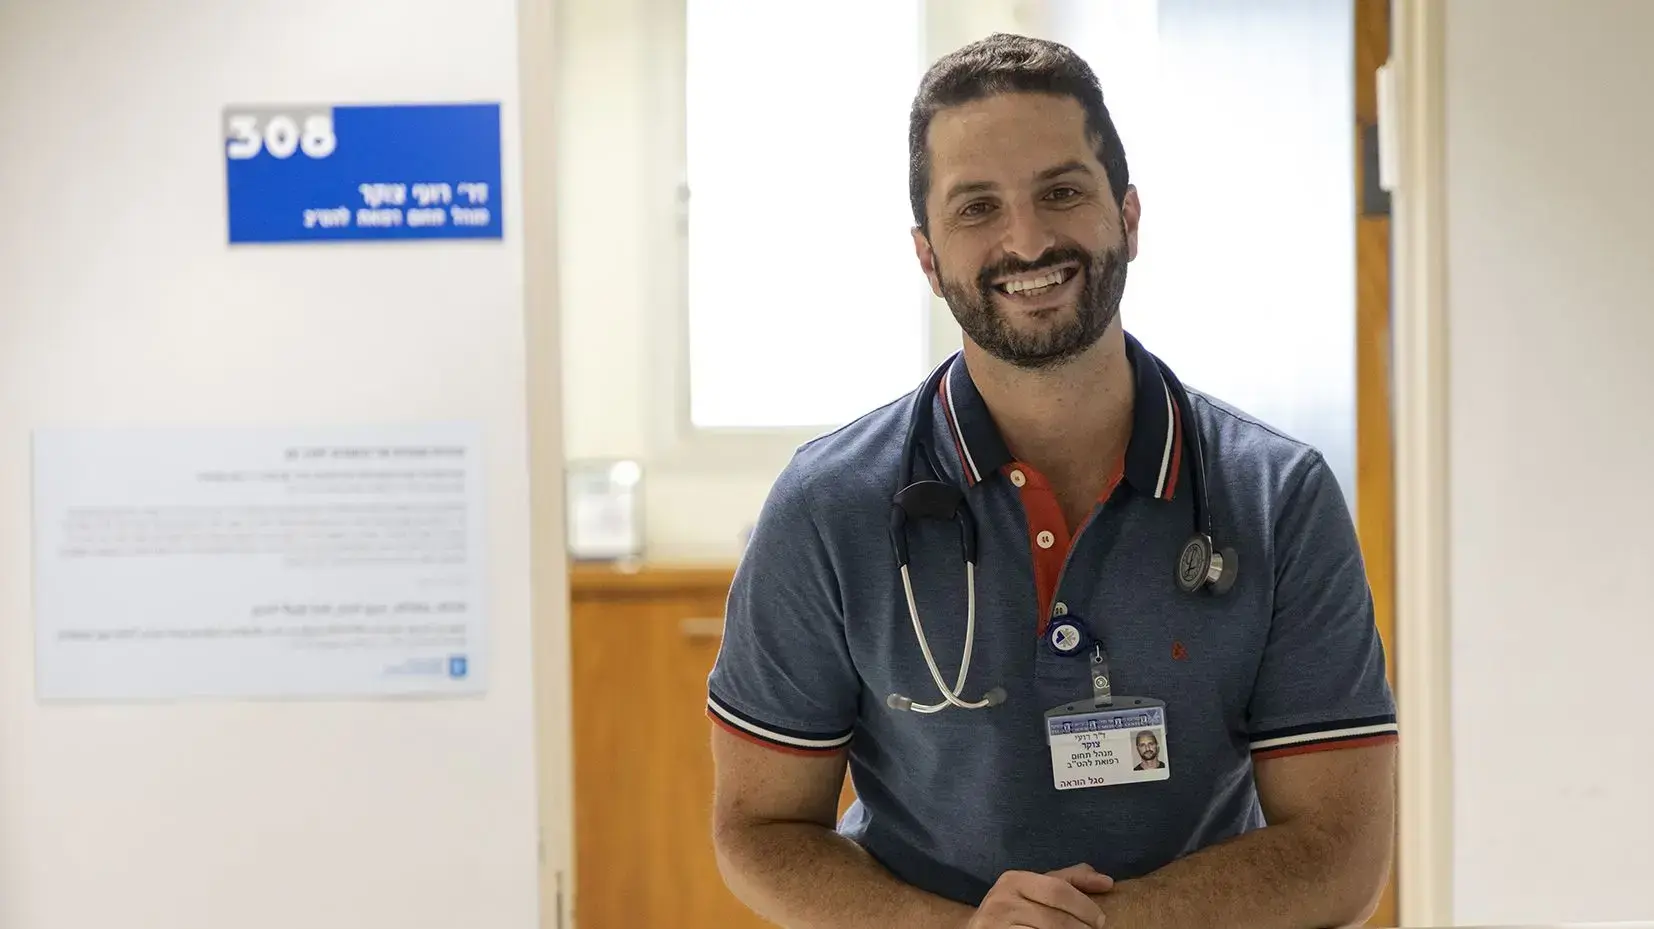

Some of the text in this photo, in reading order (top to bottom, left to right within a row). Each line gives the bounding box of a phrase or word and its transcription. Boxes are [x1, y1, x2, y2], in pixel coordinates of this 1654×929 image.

[227, 114, 337, 160] 308
[358, 182, 407, 208] צוקר
[412, 182, 452, 207] רועי
[1075, 733, 1090, 742] רועי
[1081, 741, 1100, 750] צוקר
[1071, 750, 1113, 760] מנהל תחום
[1067, 758, 1119, 769] רפואת להט"ב
[1060, 776, 1104, 788] סגל הוראה
